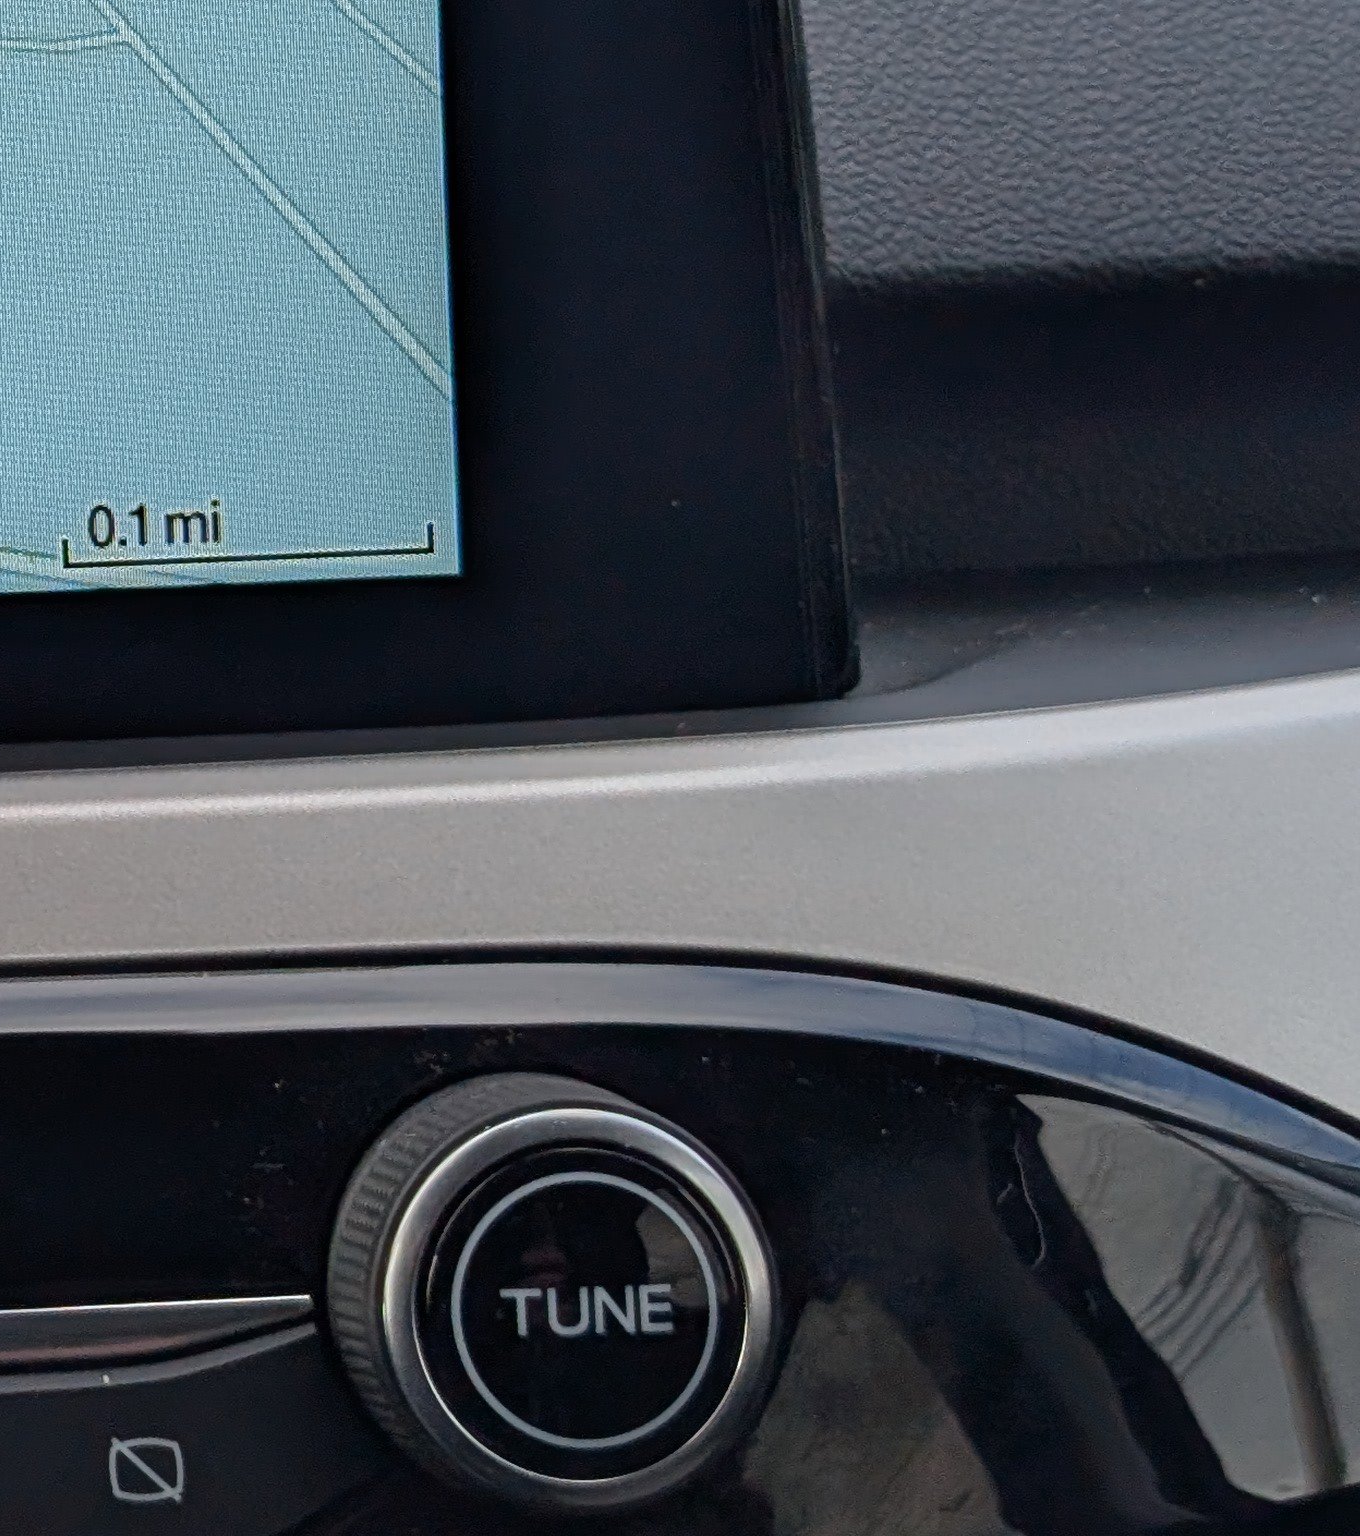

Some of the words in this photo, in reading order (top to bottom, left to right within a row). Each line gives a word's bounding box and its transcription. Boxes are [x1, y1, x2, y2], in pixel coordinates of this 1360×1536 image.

[88, 503, 149, 549] 0.1
[165, 500, 221, 545] mi
[497, 1284, 675, 1340] TUNE
